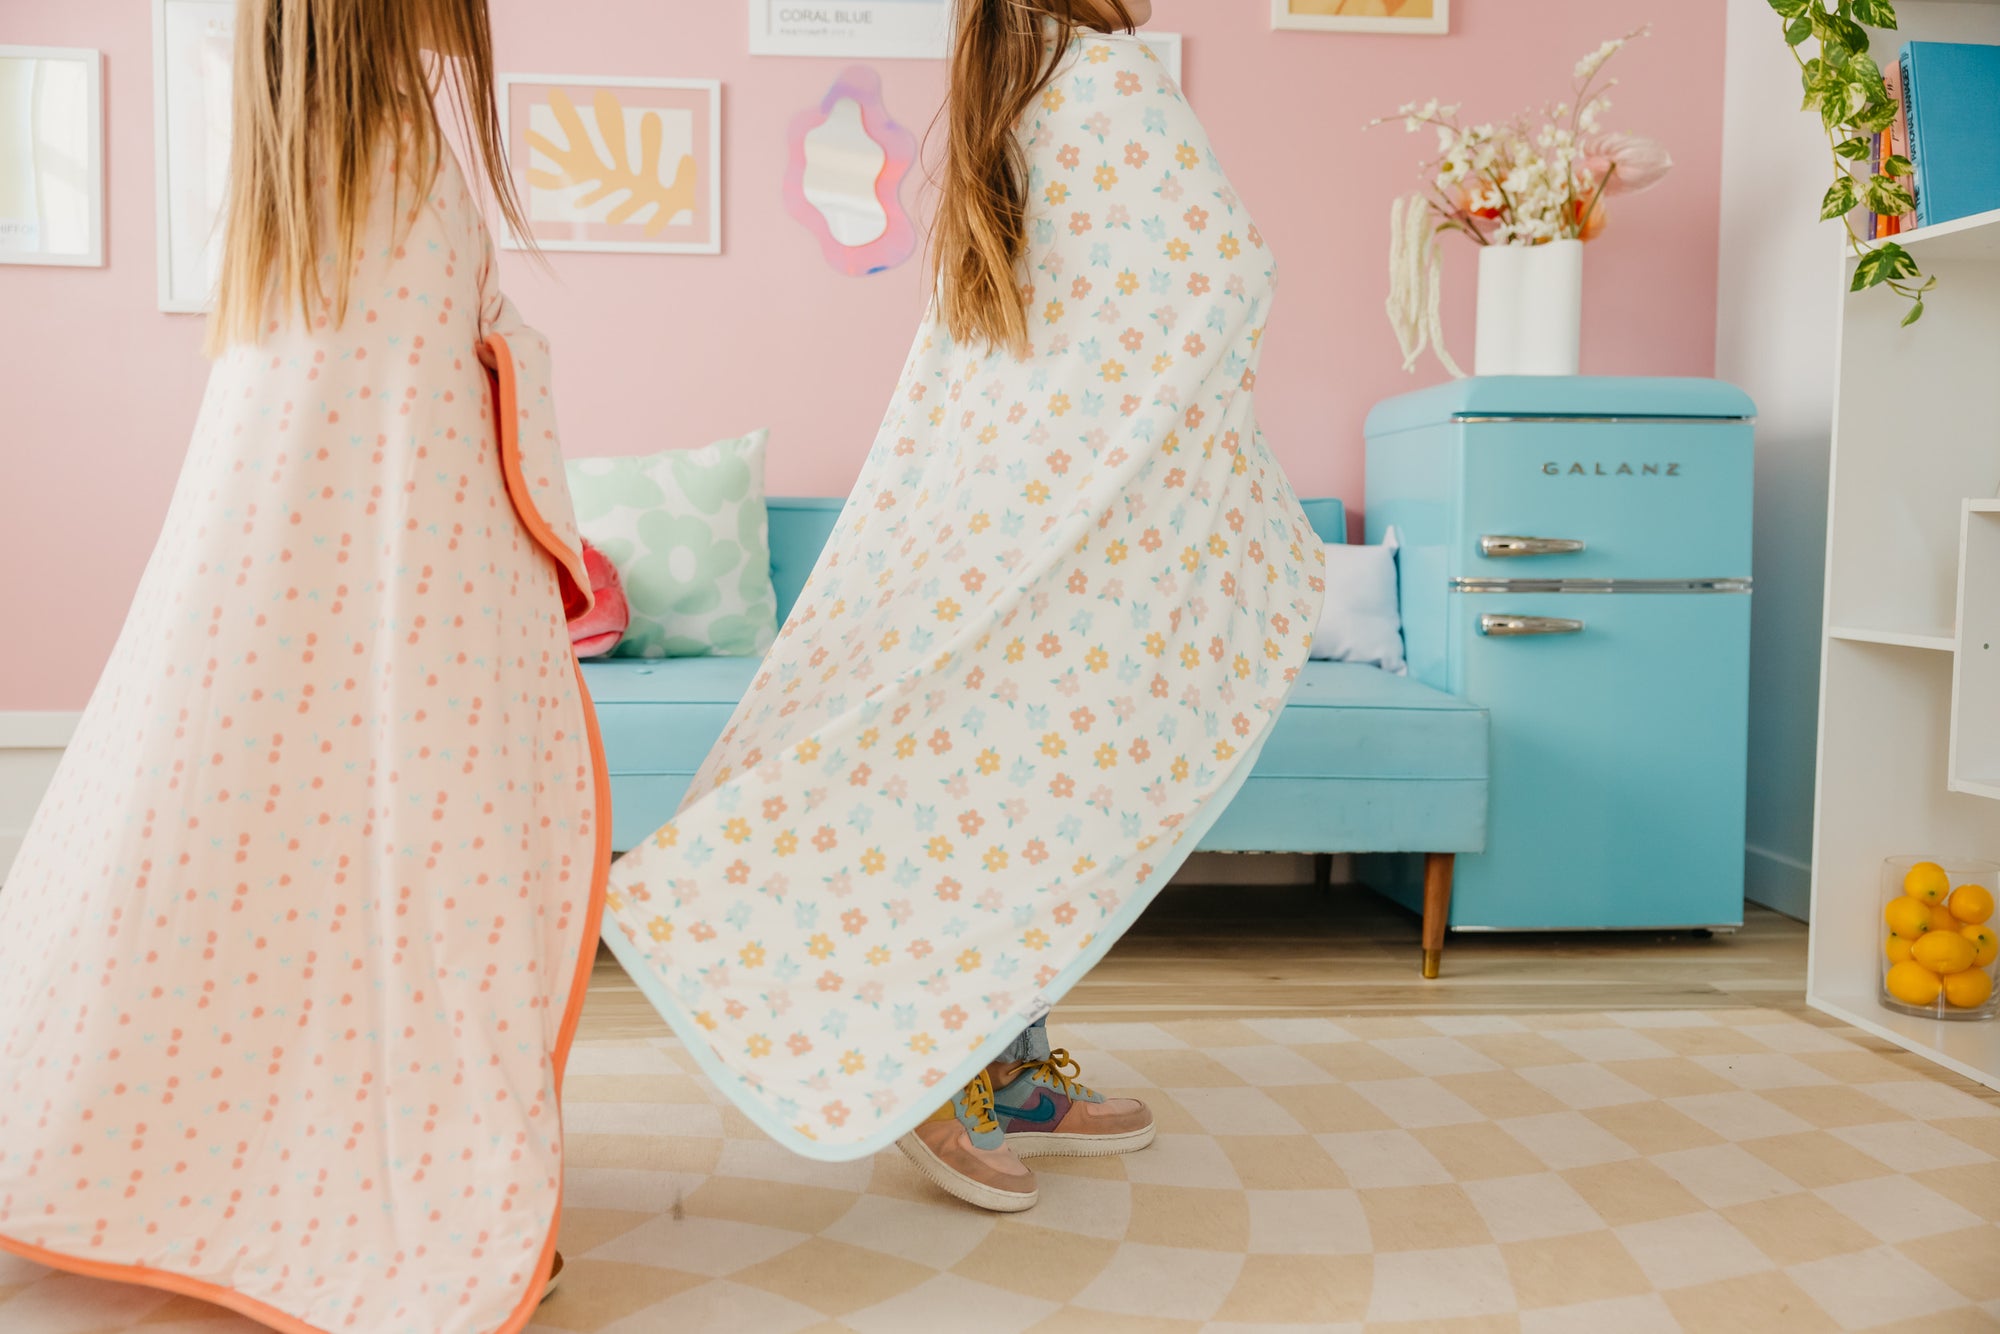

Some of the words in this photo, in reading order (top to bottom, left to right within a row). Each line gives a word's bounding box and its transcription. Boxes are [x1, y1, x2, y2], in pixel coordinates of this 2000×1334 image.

[780, 8, 829, 24] CORAL
[835, 9, 872, 24] BLUE
[1902, 65, 1912, 113] MANAGER
[1907, 112, 1917, 161] RATIONAL
[1541, 461, 1681, 476] GALANZ
